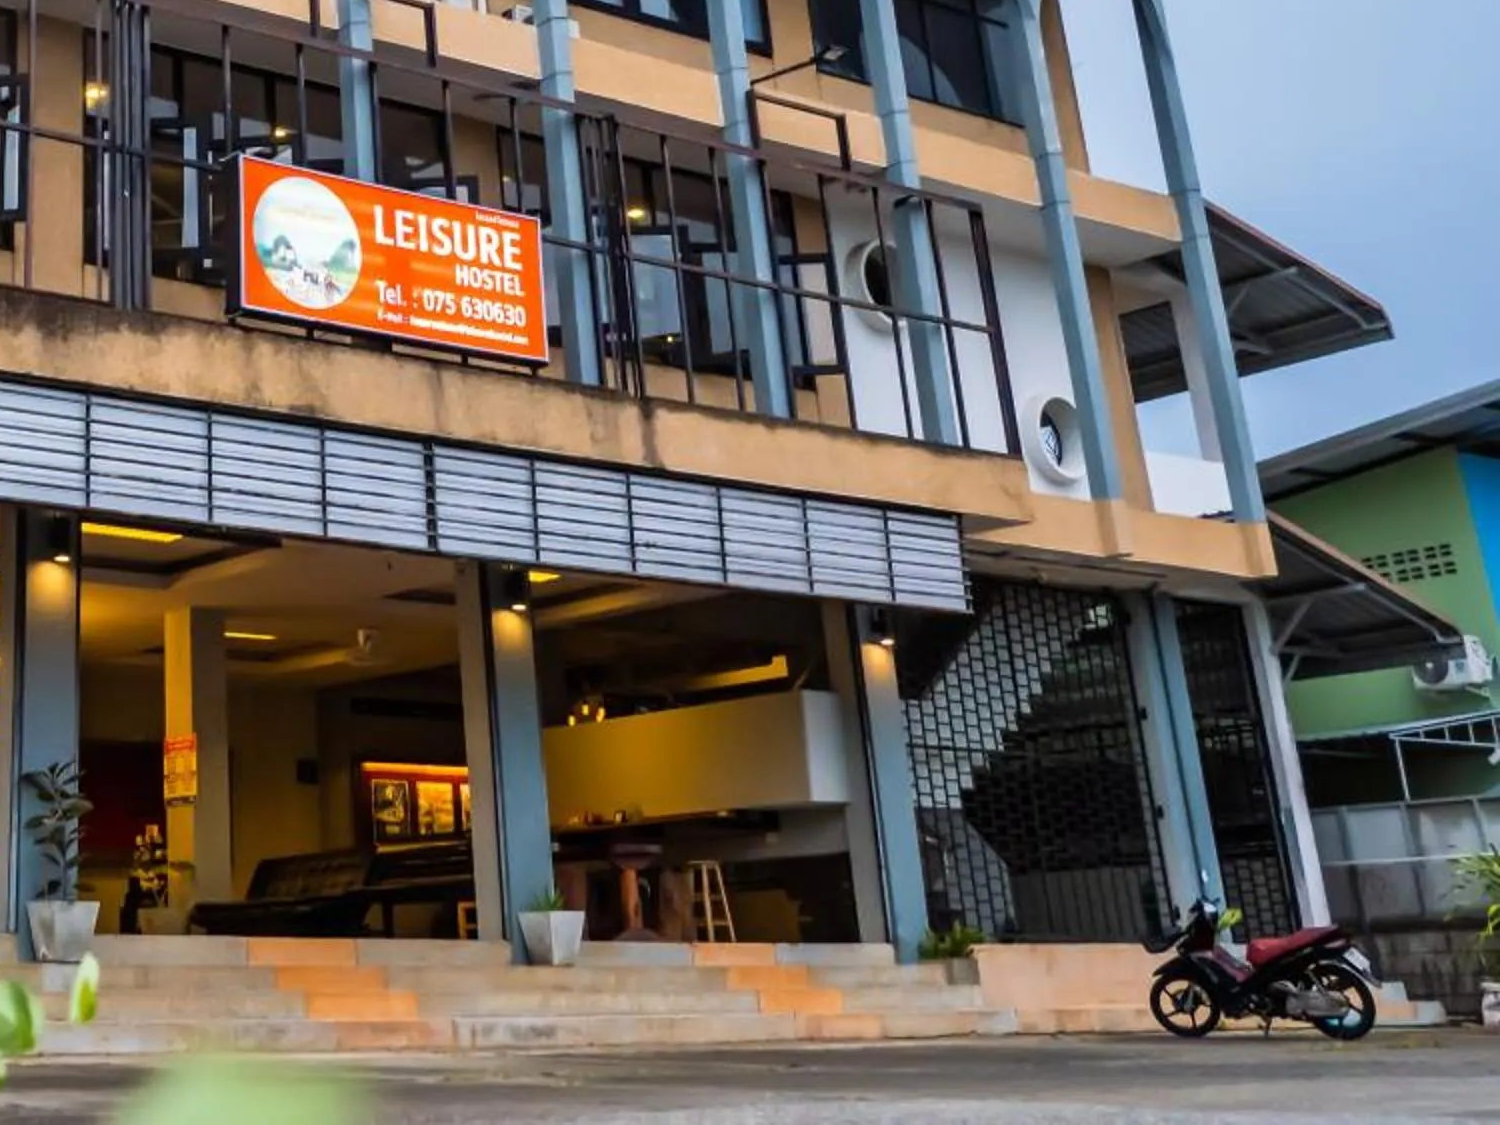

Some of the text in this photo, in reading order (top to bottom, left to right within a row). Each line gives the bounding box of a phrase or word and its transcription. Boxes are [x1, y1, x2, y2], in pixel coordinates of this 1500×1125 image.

[373, 204, 523, 271] LEISURE
[375, 280, 407, 307] Tel.
[422, 289, 456, 315] 075
[460, 296, 526, 328] 630630
[455, 264, 525, 297] HOSTEL
